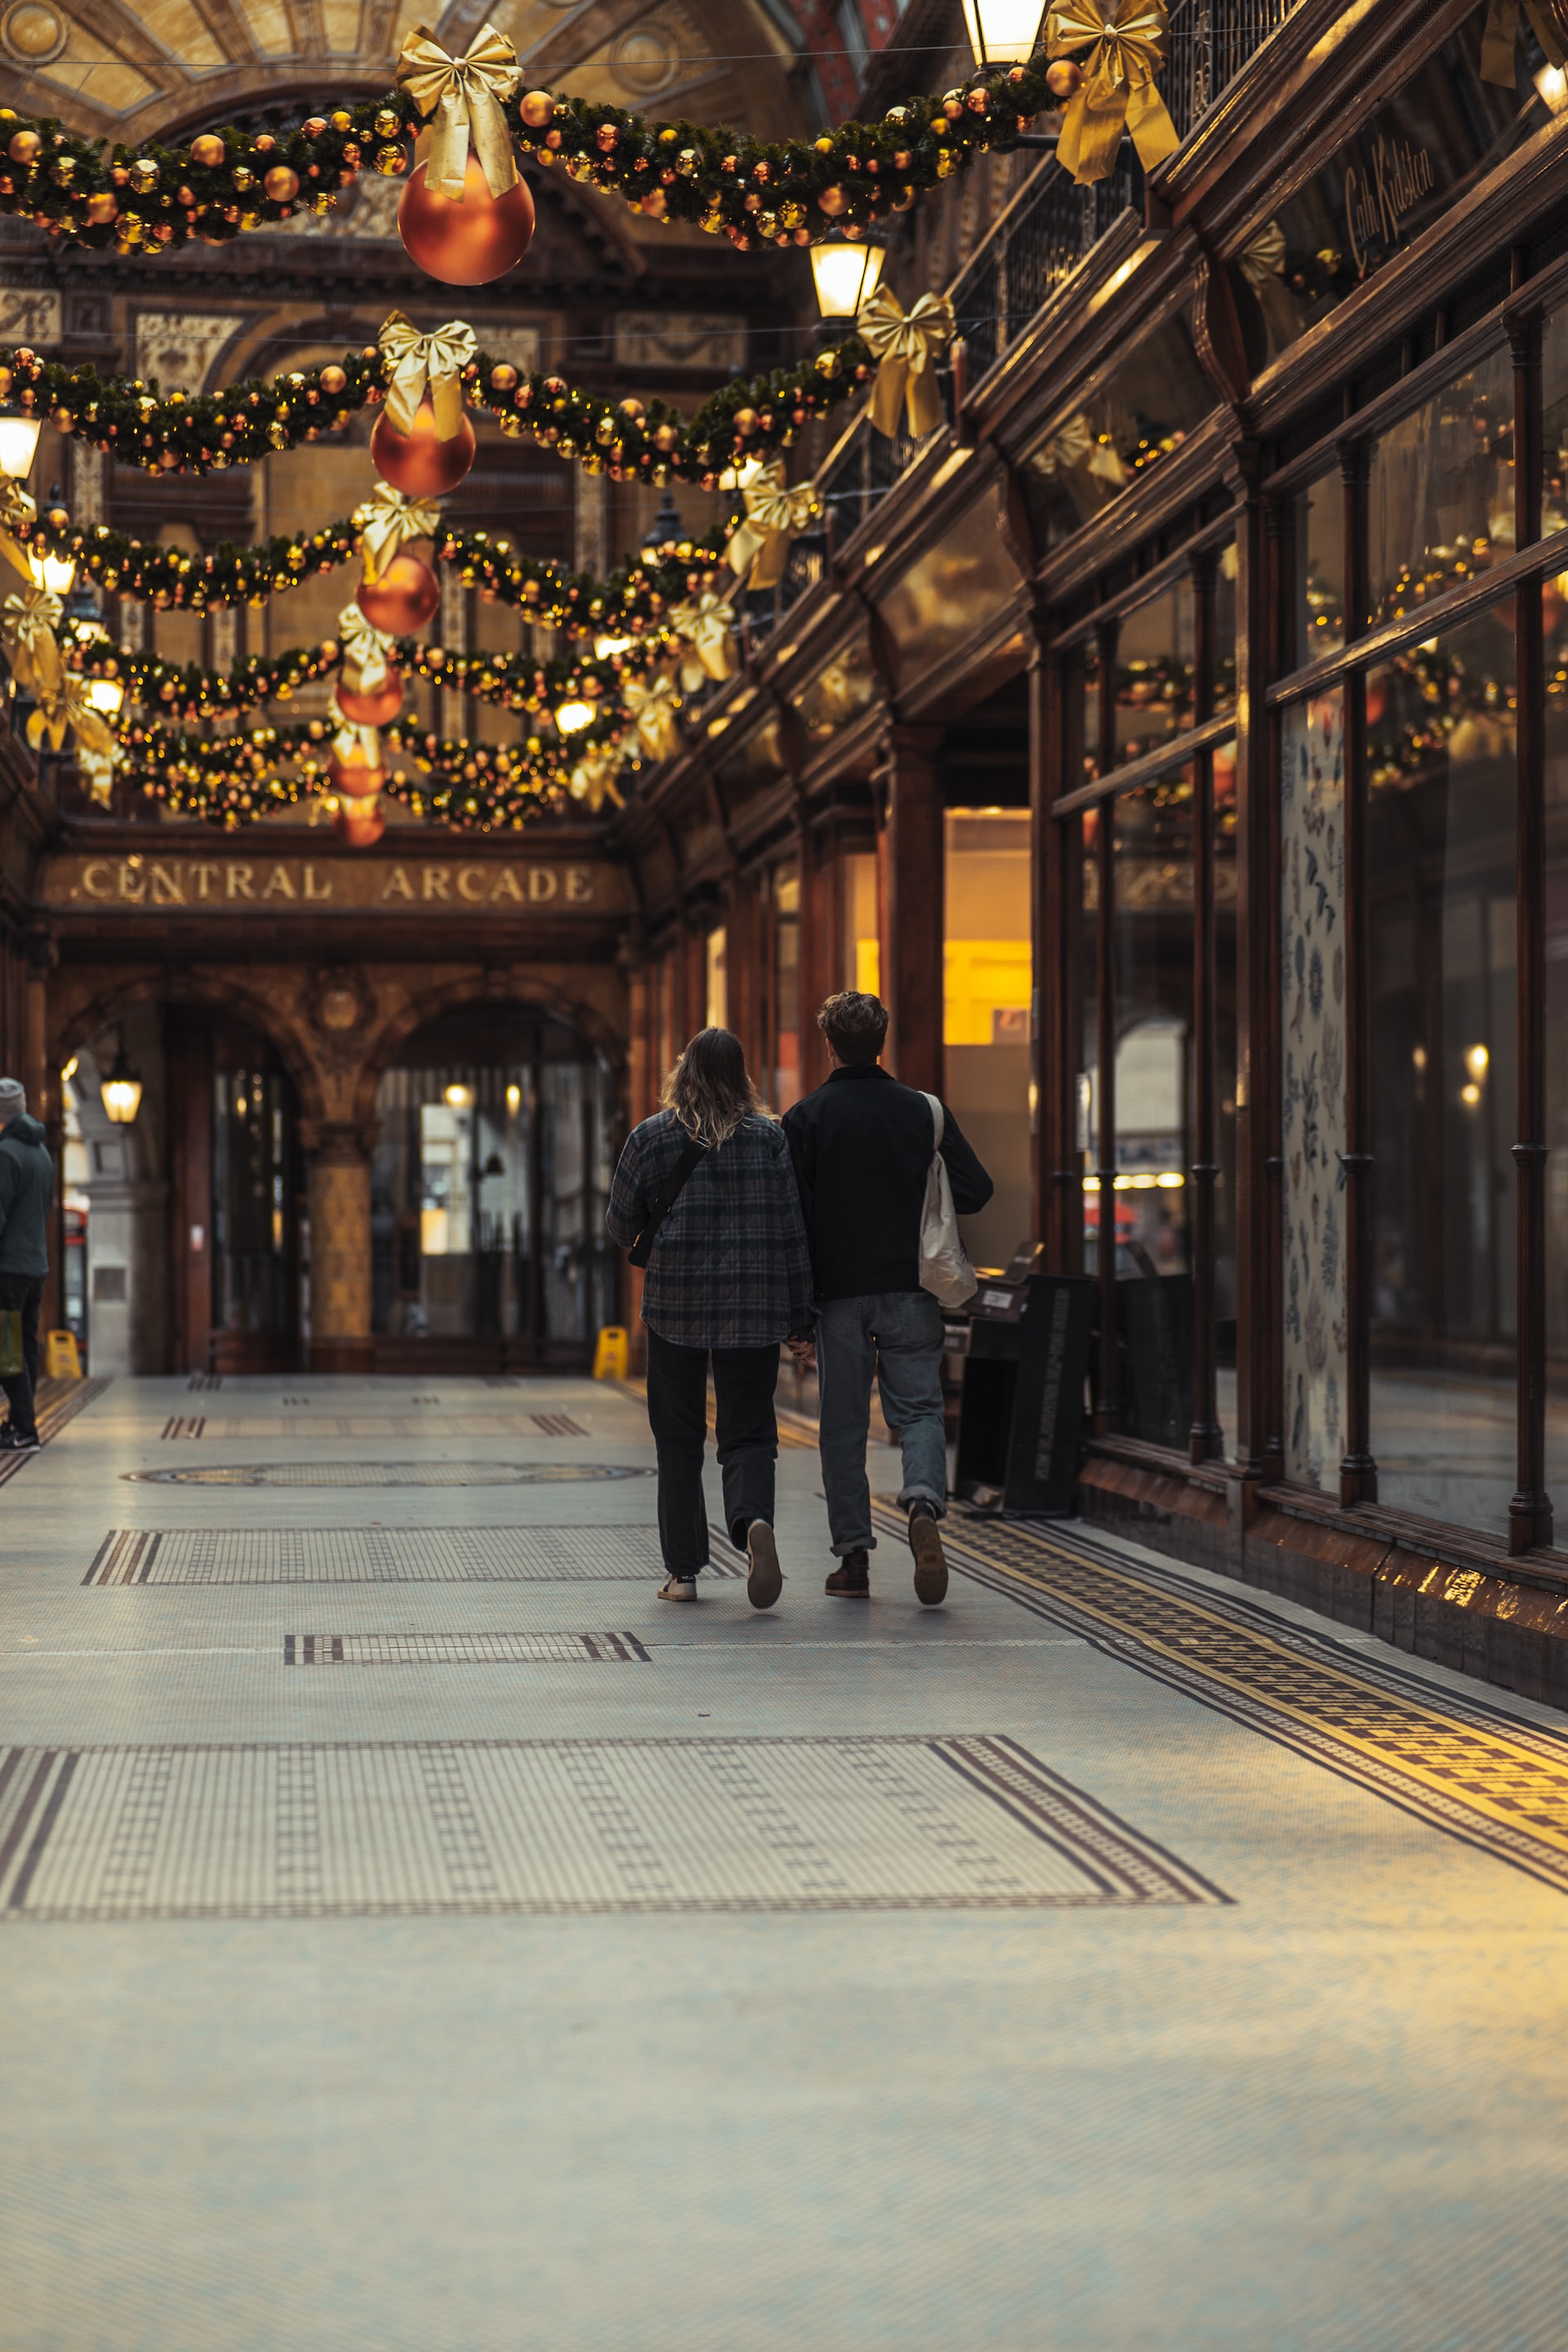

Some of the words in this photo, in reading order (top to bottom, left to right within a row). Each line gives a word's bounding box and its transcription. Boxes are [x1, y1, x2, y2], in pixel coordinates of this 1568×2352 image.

[1345, 166, 1380, 273] Cath
[1372, 133, 1433, 244] Kidston
[82, 860, 332, 900] CENTRAL
[381, 863, 595, 902] ARCADE
